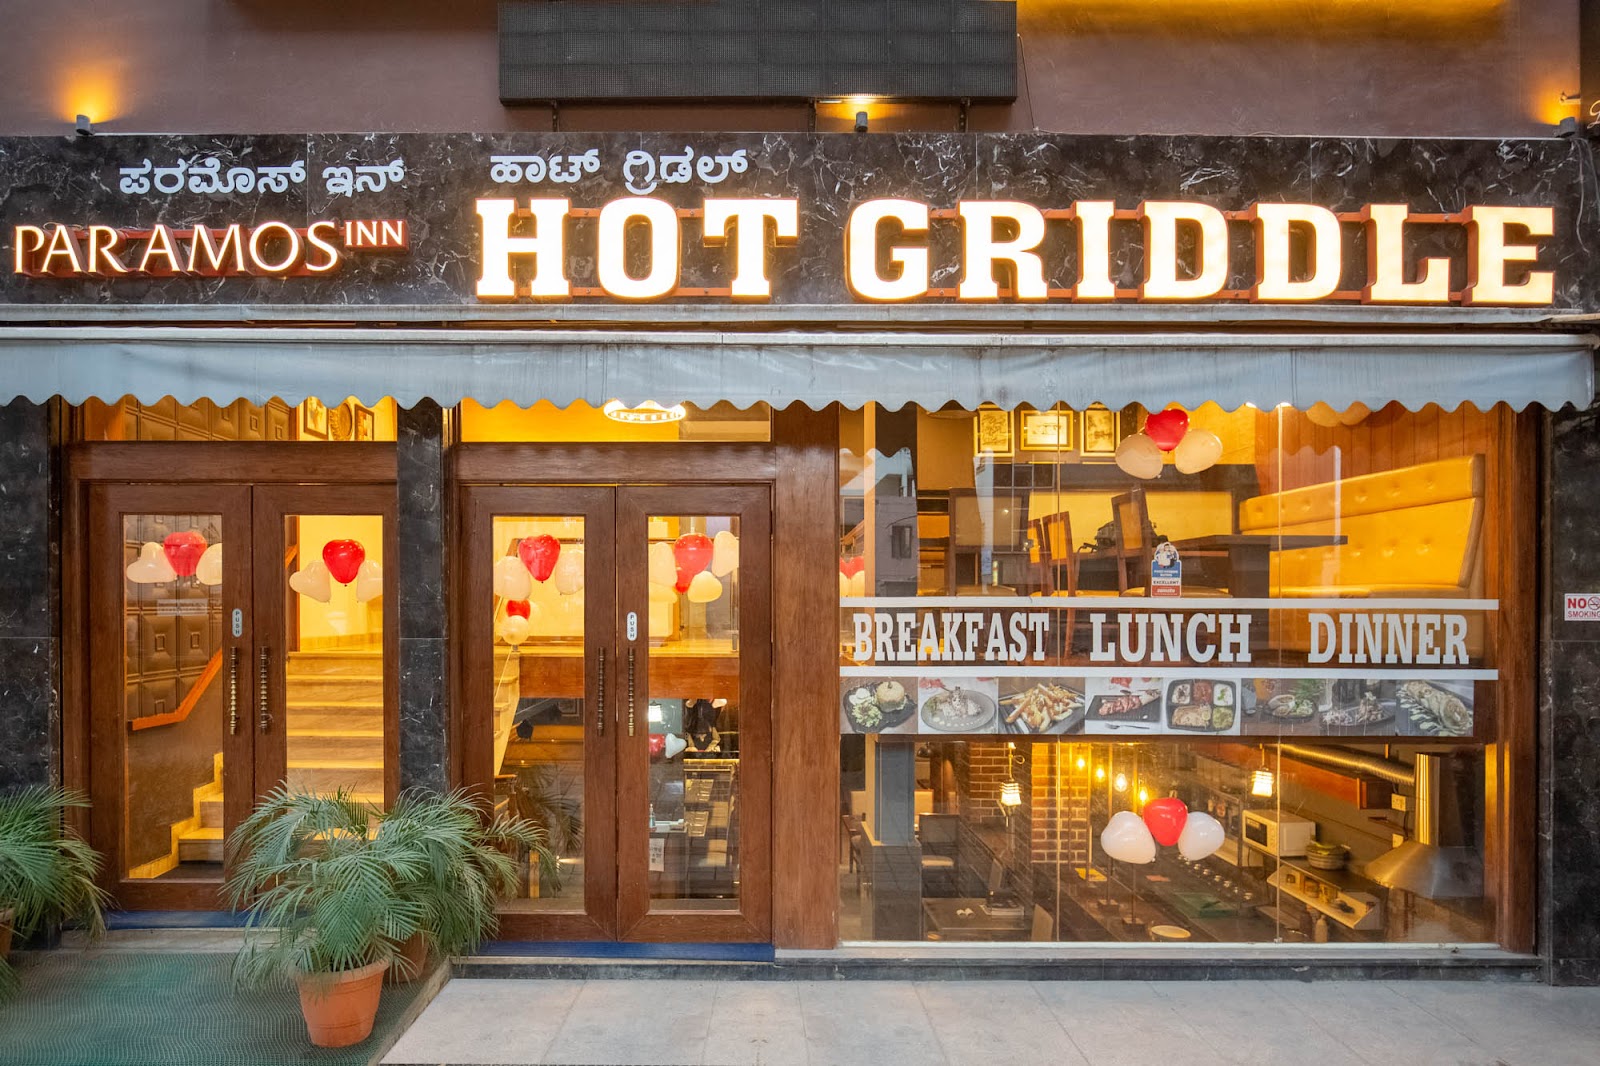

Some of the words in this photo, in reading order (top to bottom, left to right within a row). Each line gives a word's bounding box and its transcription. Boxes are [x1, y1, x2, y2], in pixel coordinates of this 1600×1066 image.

[322, 158, 404, 197] ಇನ್
[490, 148, 600, 184] ಹಾಟ್
[622, 145, 749, 195] ಗ್ರಿಡಲ್
[13, 220, 339, 275] PARAMOS
[344, 220, 404, 246] INN
[476, 197, 800, 299] HOT
[848, 198, 1555, 305] GRIDDLE
[1567, 597, 1587, 609] NO
[852, 612, 1049, 662] BREAKFAST
[1089, 612, 1252, 664] LUNCH
[1307, 612, 1470, 665] DINNER
